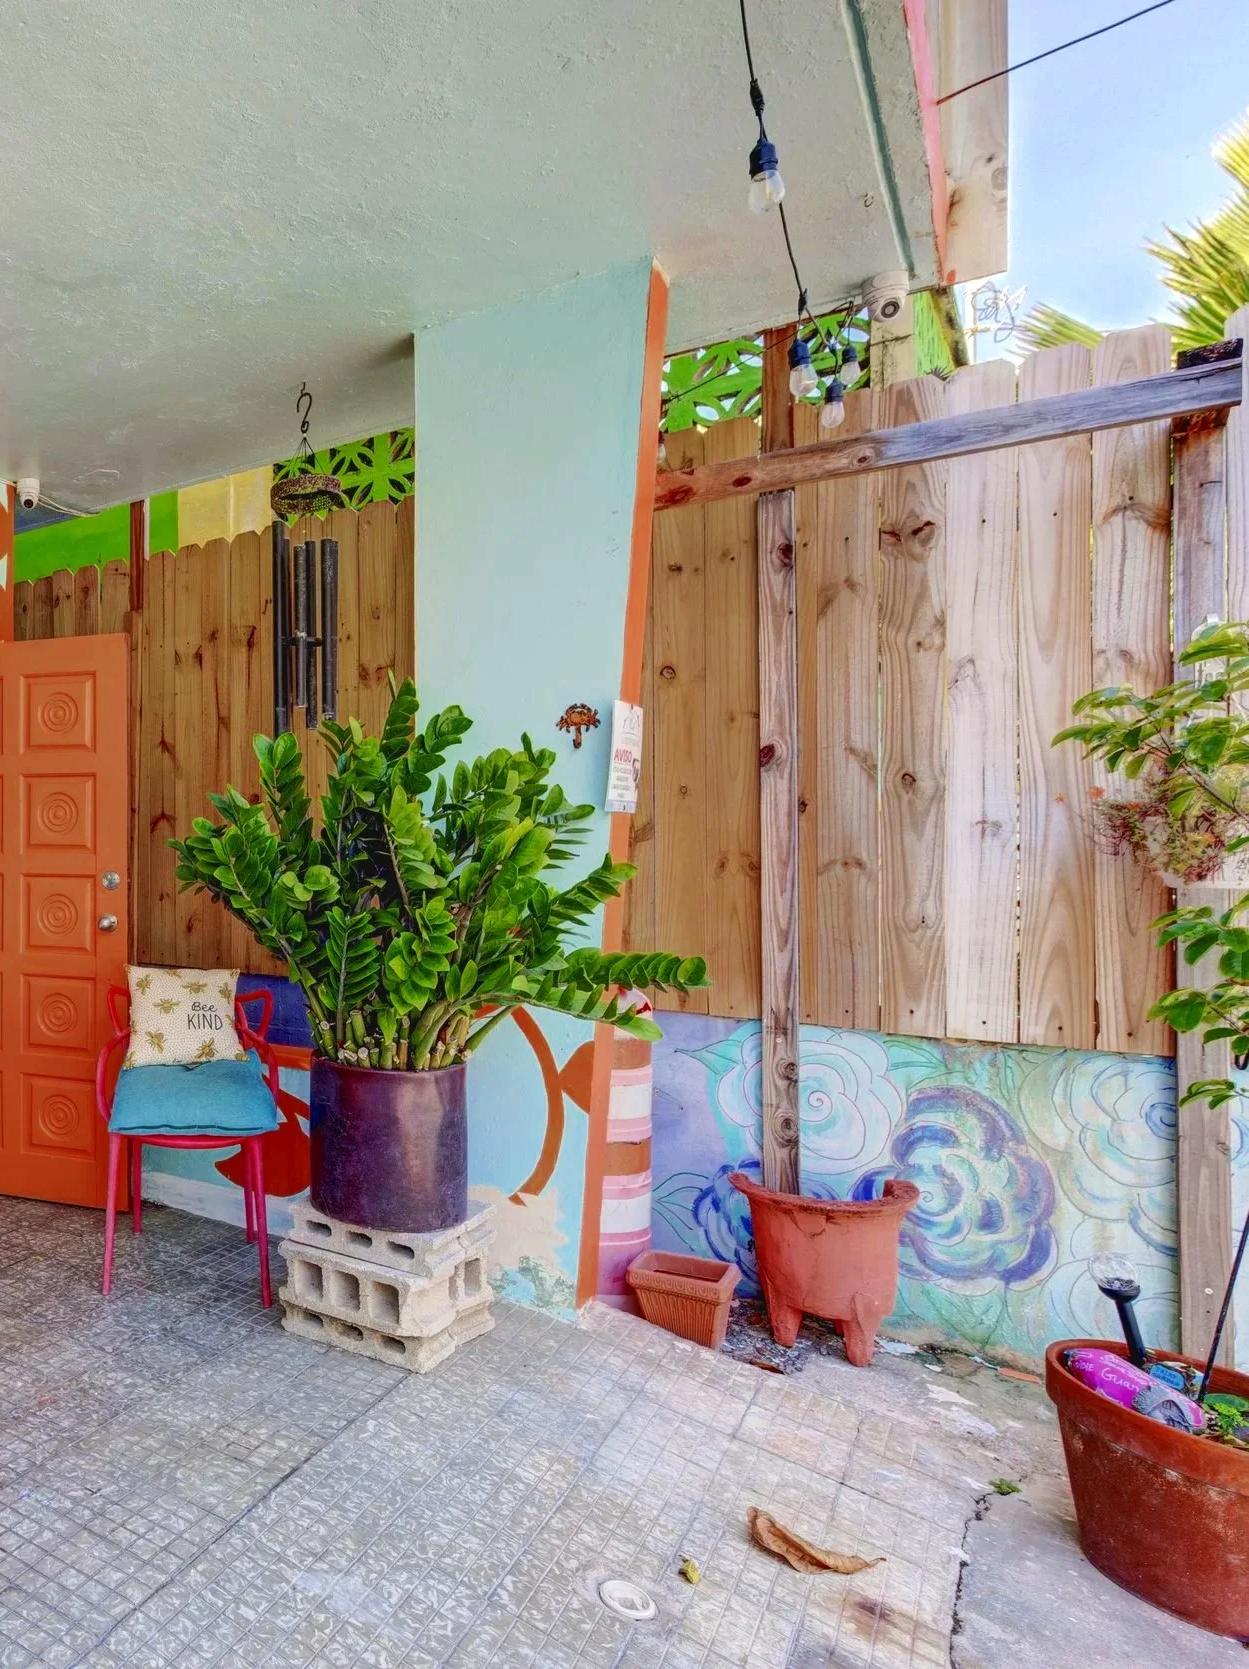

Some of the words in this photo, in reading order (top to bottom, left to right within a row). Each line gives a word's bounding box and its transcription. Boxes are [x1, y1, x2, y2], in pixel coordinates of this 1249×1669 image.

[613, 748, 632, 763] AVISO
[191, 1002, 217, 1012] Bee
[187, 1013, 223, 1030] KIND
